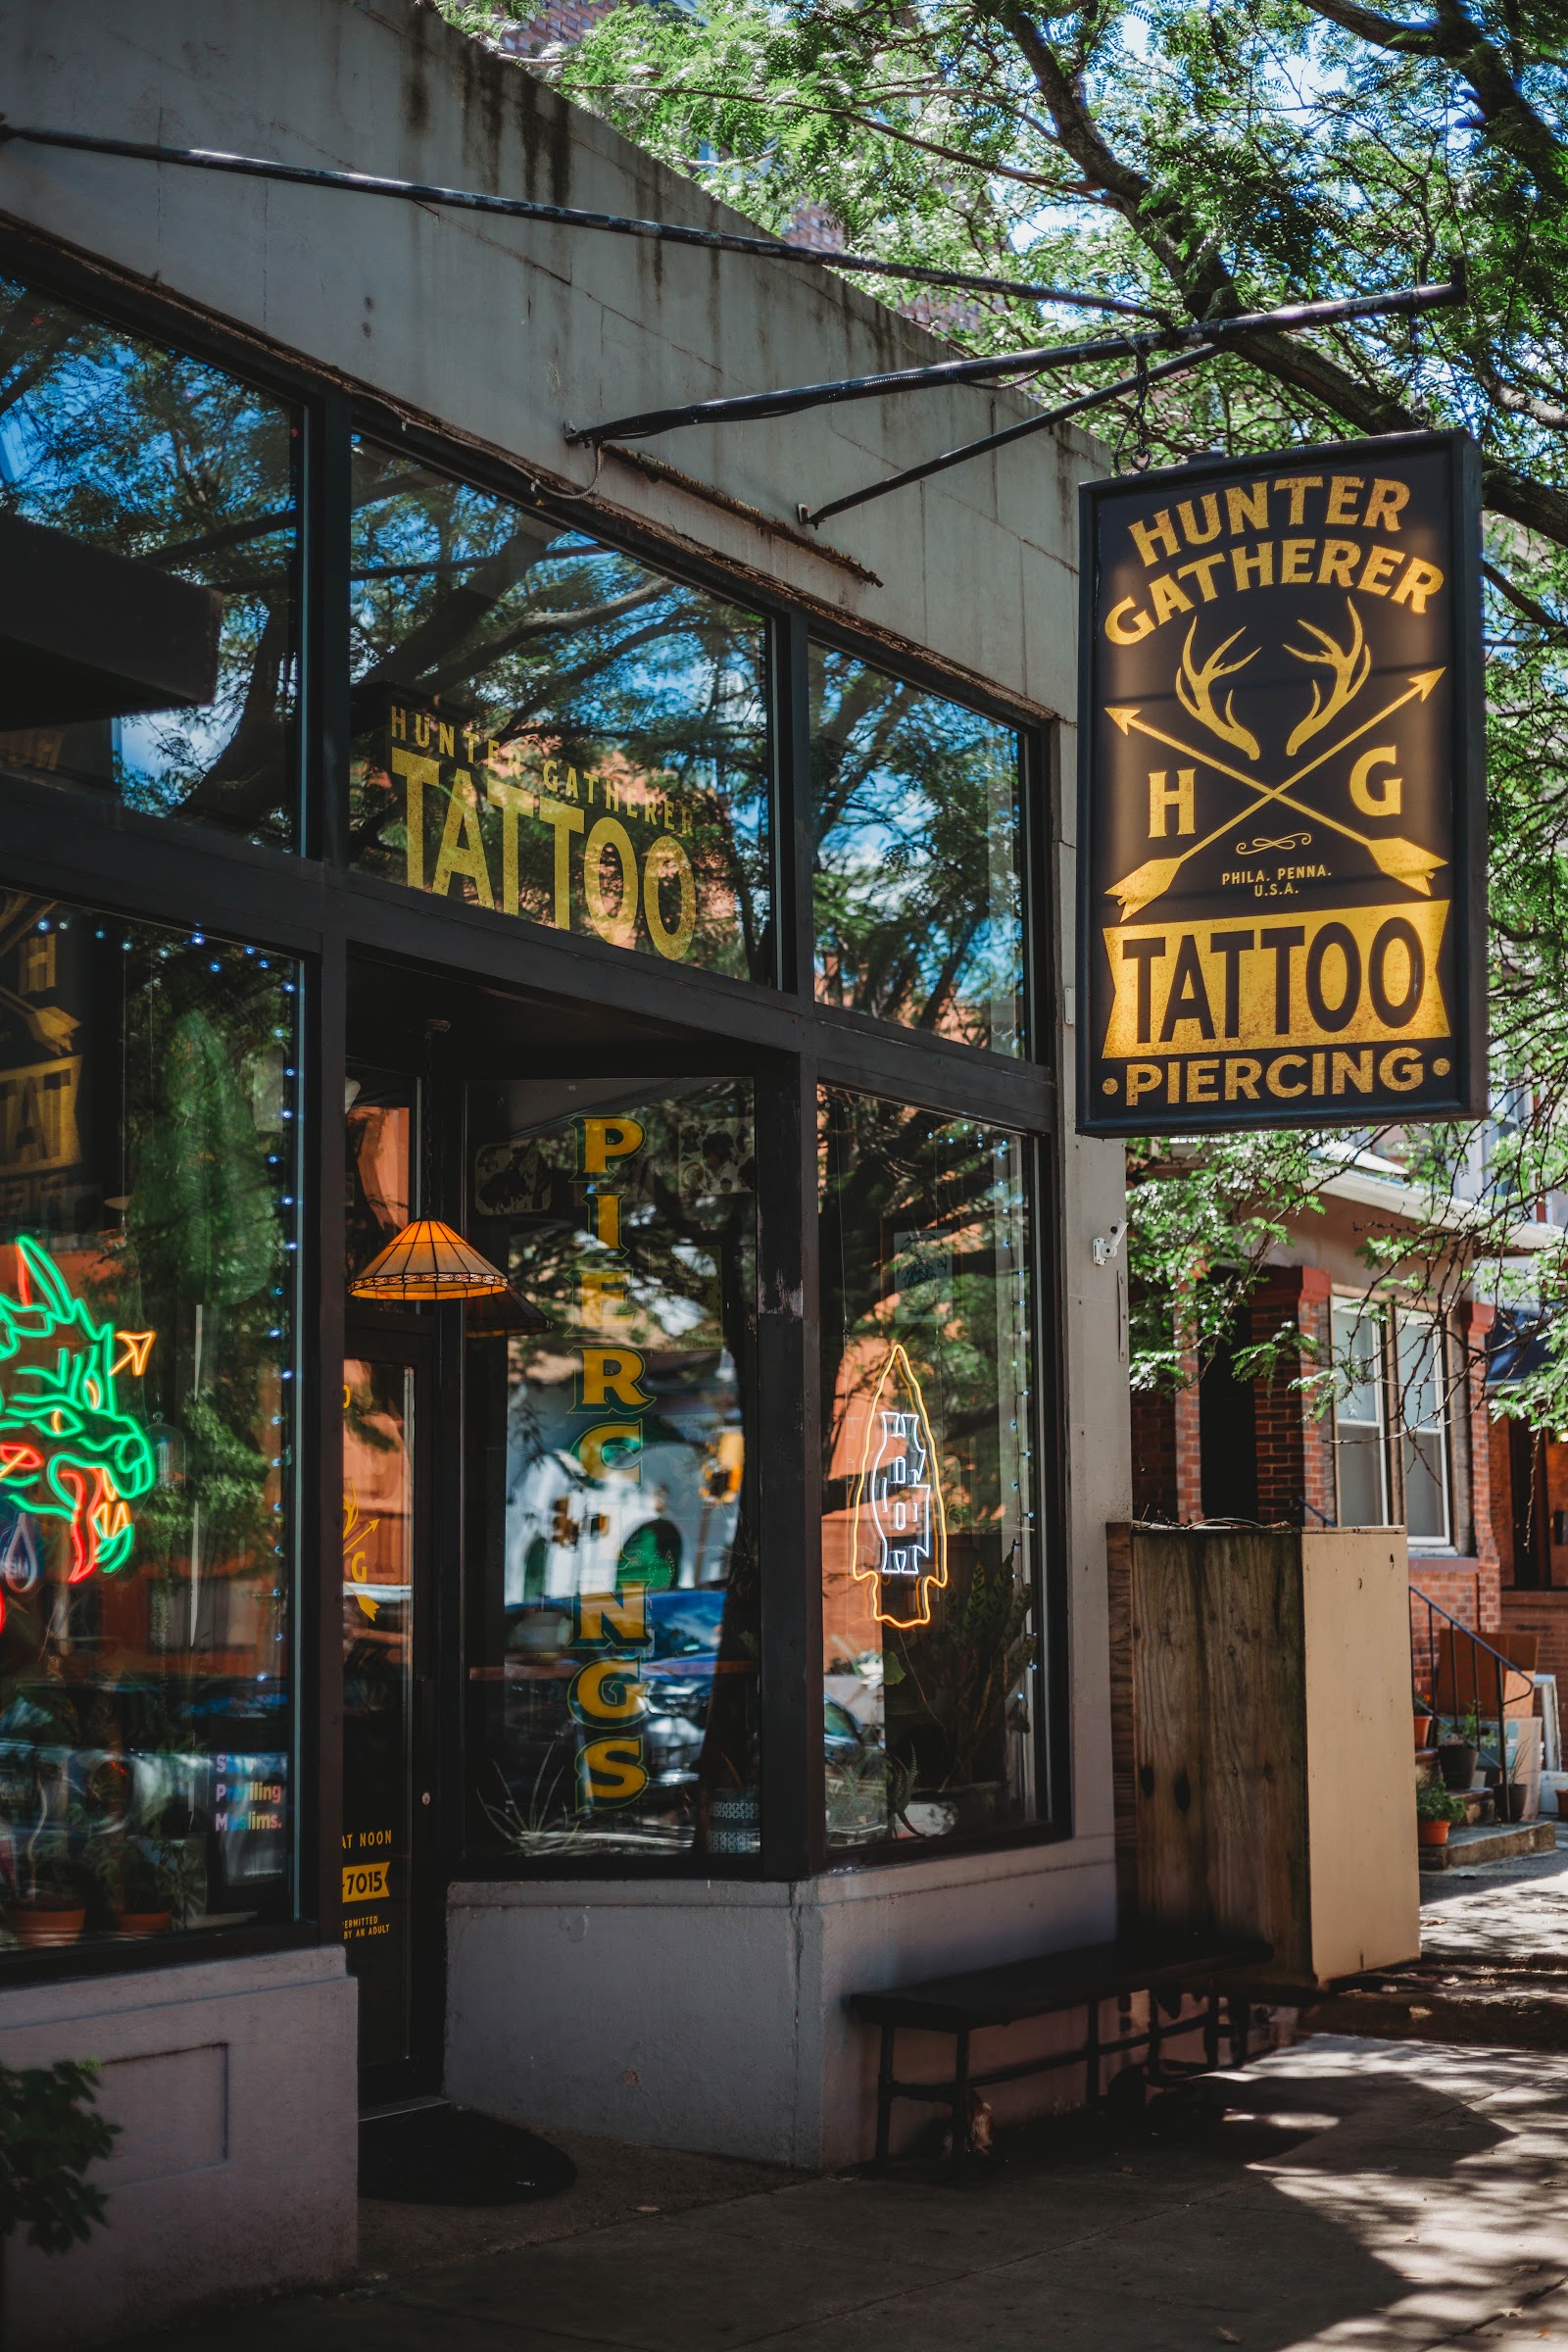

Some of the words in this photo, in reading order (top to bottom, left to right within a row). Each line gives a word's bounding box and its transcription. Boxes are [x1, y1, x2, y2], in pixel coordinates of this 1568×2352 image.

[1128, 475, 1411, 566] HUNTER
[1104, 538, 1445, 646] GATHERER
[391, 706, 522, 780] HUNTER
[543, 760, 694, 837] GATHERER
[1149, 768, 1196, 838] H
[1349, 745, 1402, 816] G
[392, 746, 697, 960] TATTOO
[1222, 868, 1270, 886] PHILA.
[1278, 864, 1332, 881] PENNA.
[1254, 882, 1299, 898] U.S.A.
[1123, 916, 1425, 1044] TATTOO
[1126, 1047, 1424, 1106] PIERCING
[216, 1782, 282, 1804] Profiling
[215, 1811, 282, 1832] Muslims.
[360, 1830, 392, 1847] NOON
[343, 1915, 378, 1930] ERMITTED
[343, 1930, 353, 1939] BY
[356, 1928, 366, 1938] AN
[368, 1924, 390, 1936] ADULT
